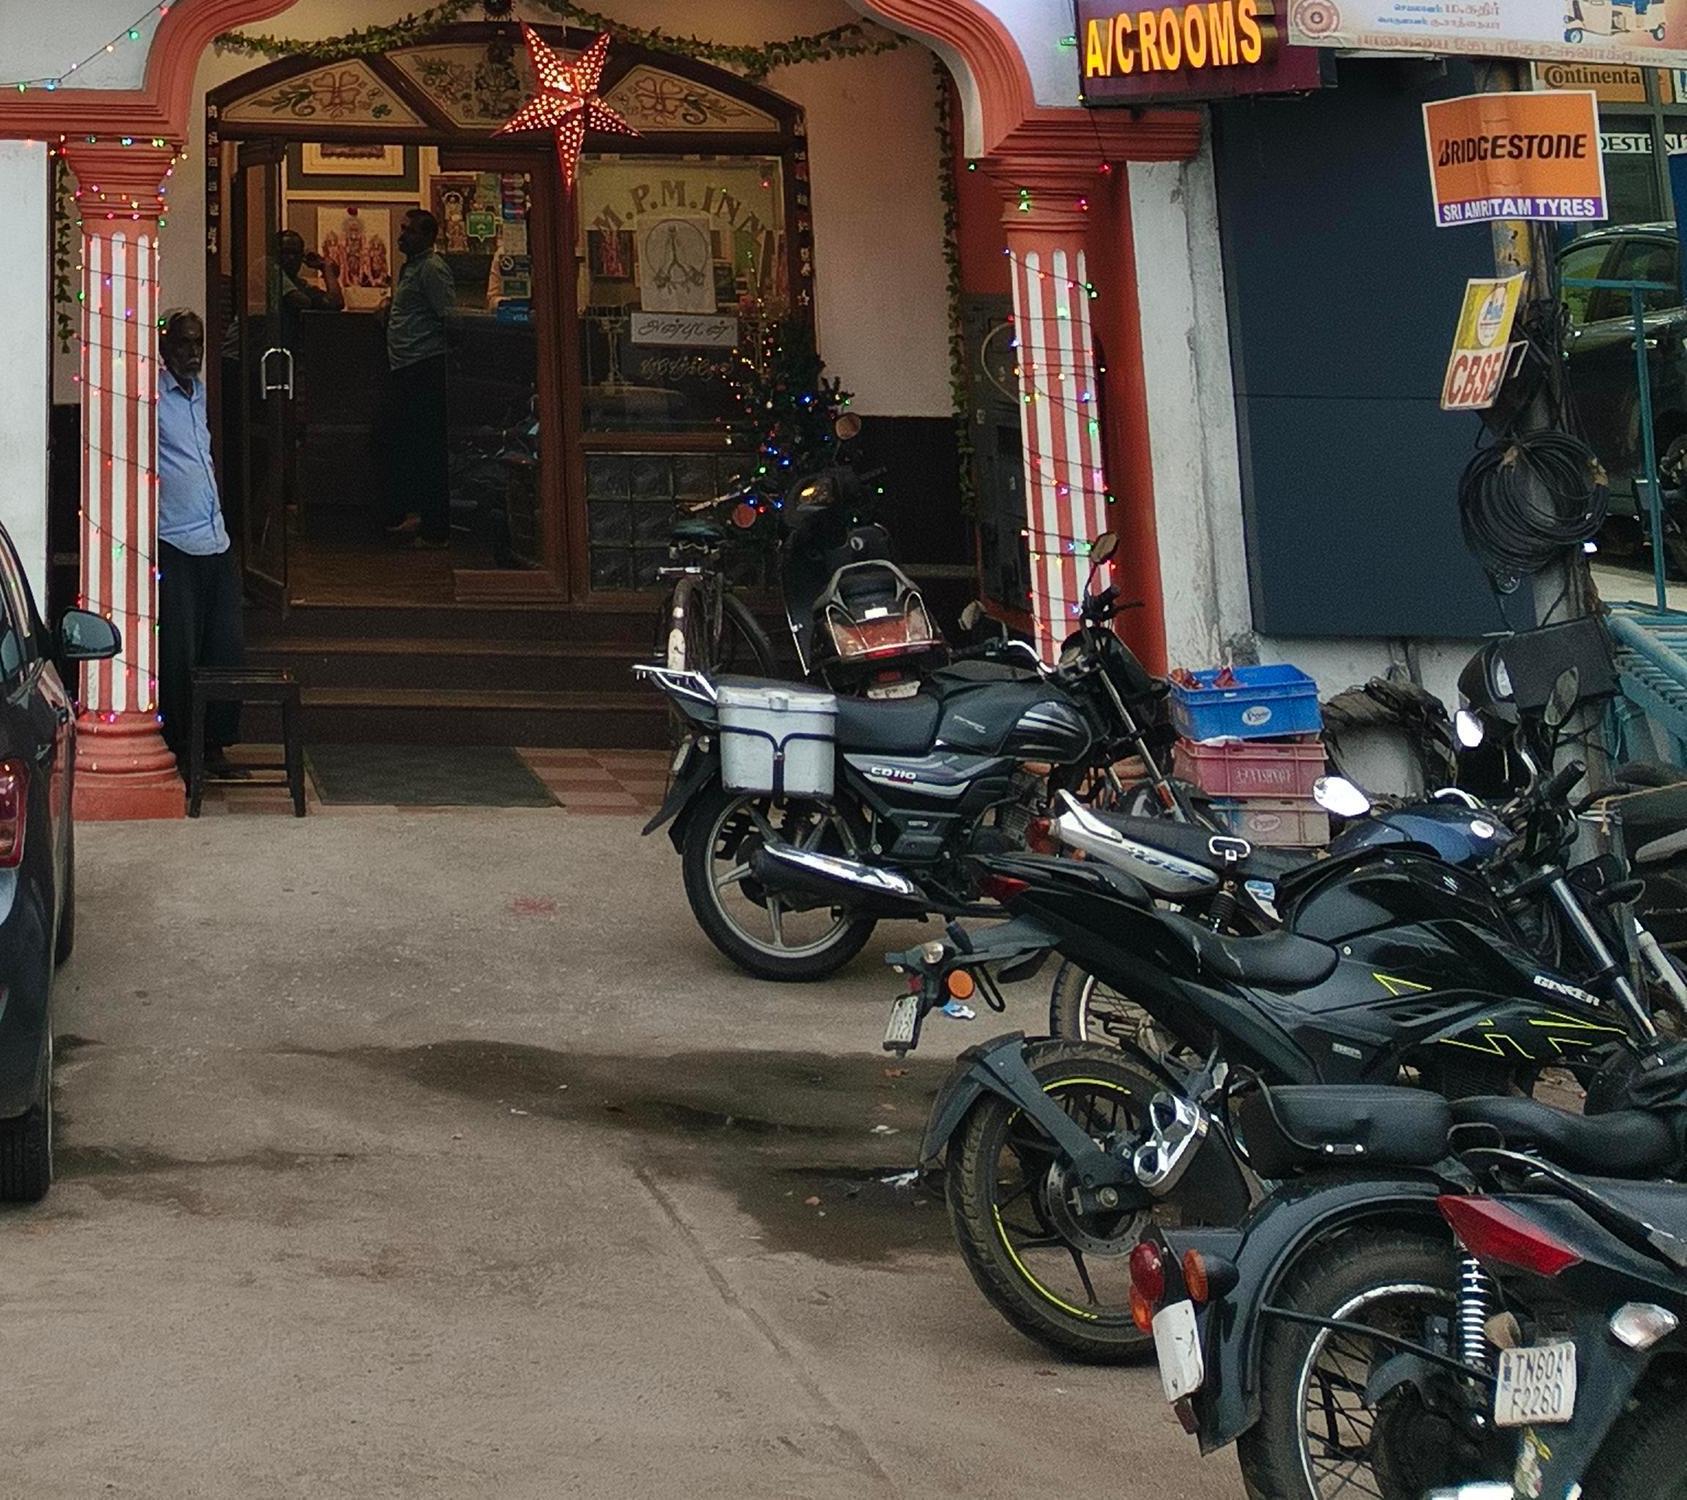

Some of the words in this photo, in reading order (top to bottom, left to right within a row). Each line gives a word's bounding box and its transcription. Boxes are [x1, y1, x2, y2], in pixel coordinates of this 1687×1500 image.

[1086, 12, 1135, 78] A/C
[1543, 64, 1640, 88] Continenta
[1438, 133, 1587, 167] BRIDGESTONE
[1443, 204, 1463, 222] SRI
[1464, 197, 1532, 218] AMRITAM
[1535, 198, 1596, 217] TYRES
[1447, 352, 1503, 405] CBSE
